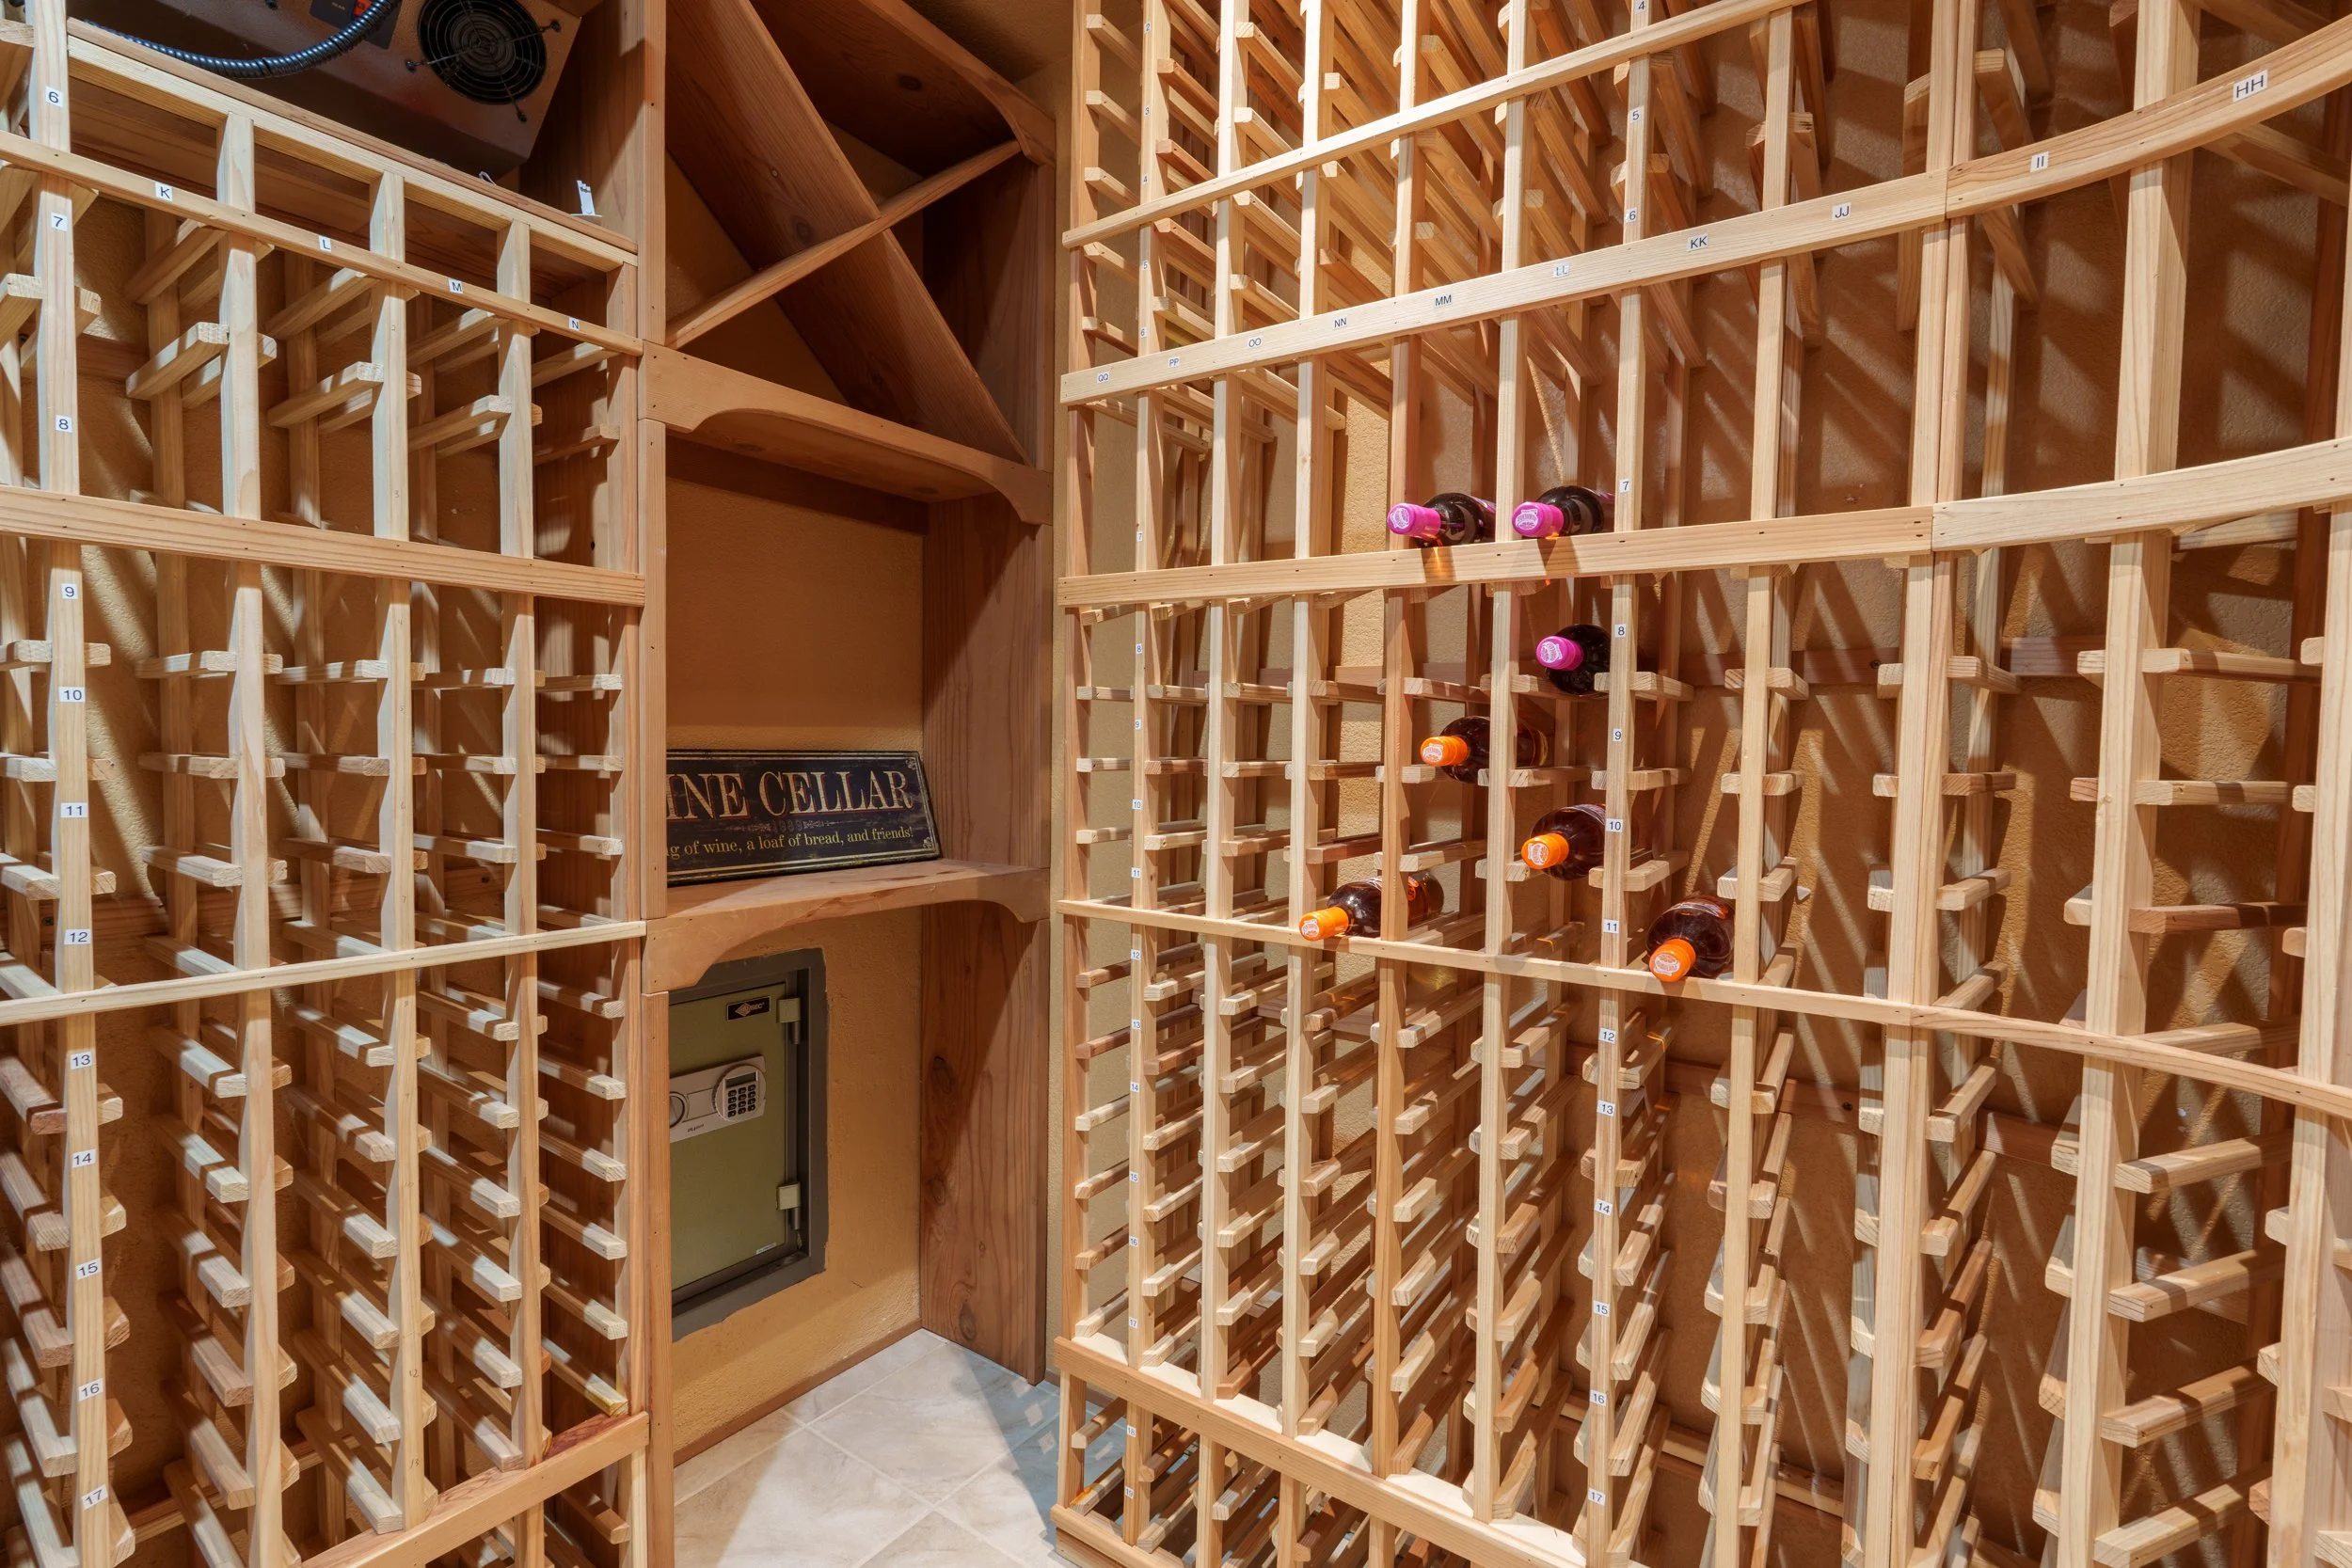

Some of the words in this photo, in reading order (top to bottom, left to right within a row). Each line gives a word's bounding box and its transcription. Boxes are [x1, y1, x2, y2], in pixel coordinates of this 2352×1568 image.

[1638, 1, 1645, 9] 4
[1146, 23, 1151, 31] 2
[2236, 75, 2265, 98] HH
[48, 92, 58, 103] 6
[1145, 106, 1150, 115] 3
[1632, 110, 1640, 120] 5
[160, 186, 170, 198] K
[1629, 211, 1636, 220] 6
[1835, 206, 1850, 218] JJ
[54, 216, 63, 227] 7
[323, 238, 330, 250] L
[1691, 236, 1708, 248] KK
[1143, 261, 1148, 270] 5
[1556, 266, 1567, 277] LL
[453, 281, 462, 292] M
[1435, 294, 1452, 307] MM
[572, 320, 579, 329] N
[1334, 317, 1347, 327] NN
[1141, 328, 1145, 337] 6
[1248, 338, 1262, 348] OO
[1168, 358, 1179, 367] PP
[1098, 373, 1108, 383] QQ
[59, 419, 69, 430] 8
[1622, 481, 1629, 490] 7
[65, 586, 74, 597] 9
[1618, 626, 1625, 636] 8
[64, 689, 82, 701] 10
[1614, 731, 1621, 740] 9
[758, 770, 912, 816] CELLAR
[1134, 800, 1141, 809] 10
[65, 805, 83, 816] 11
[1609, 821, 1621, 831] 10
[684, 840, 700, 856] of
[703, 838, 742, 855] wine,
[746, 840, 755, 850] a
[758, 832, 786, 849] loaf
[787, 832, 803, 847] of
[804, 830, 844, 847] bread,
[847, 829, 869, 843] and
[871, 827, 914, 842] friends!
[1606, 923, 1617, 932] 11
[70, 932, 87, 942] 12
[1132, 951, 1140, 959] 12
[1133, 1021, 1141, 1029] 13
[1602, 1031, 1614, 1041] 12
[72, 1055, 91, 1067] 13
[1131, 1084, 1138, 1092] 14
[1601, 1103, 1613, 1114] 13
[74, 1154, 92, 1165] 14
[1130, 1173, 1138, 1181] 15
[1598, 1202, 1610, 1213] 14
[1130, 1238, 1137, 1246] 16
[79, 1262, 99, 1275] 15
[1596, 1304, 1608, 1315] 15
[1130, 1319, 1136, 1327] 17
[82, 1384, 100, 1396] 16
[1593, 1393, 1605, 1403] 16
[1128, 1427, 1136, 1435] 18
[85, 1489, 102, 1506] 17
[1591, 1492, 1602, 1502] 17
